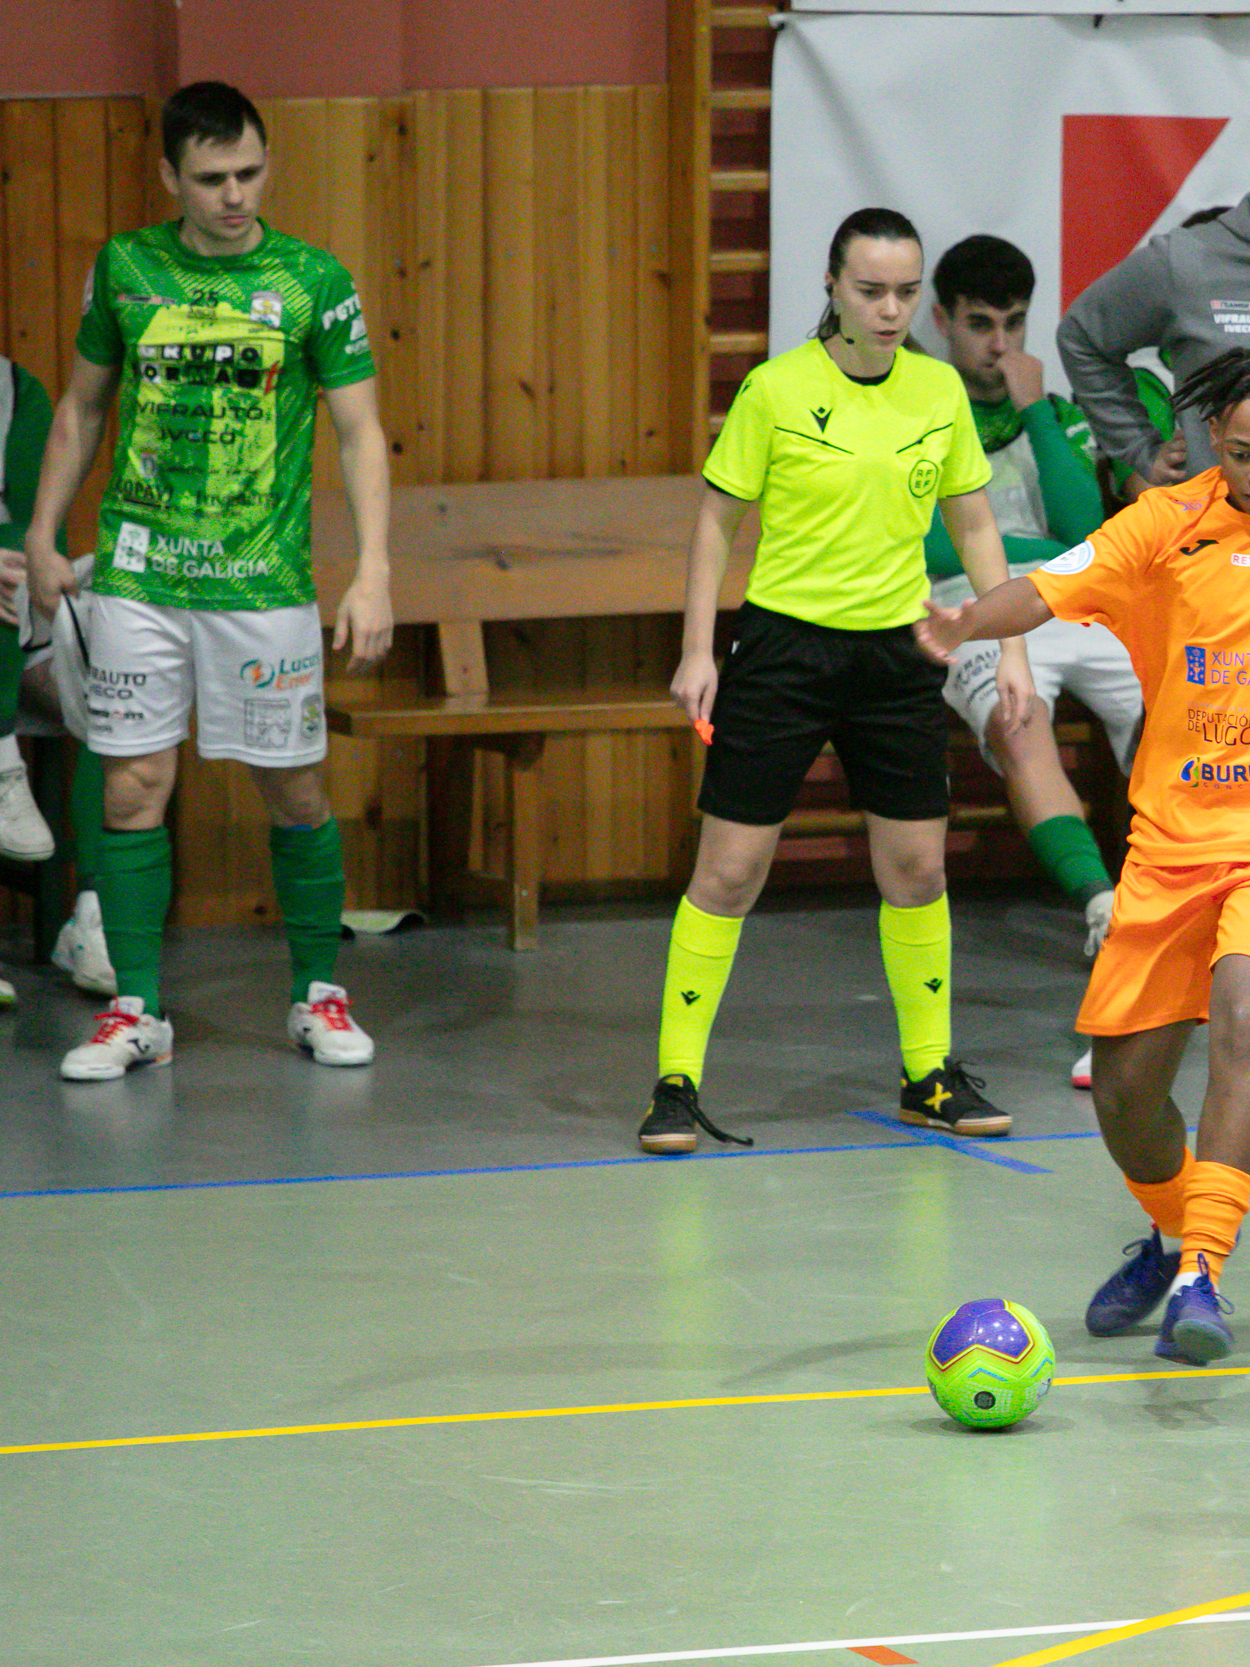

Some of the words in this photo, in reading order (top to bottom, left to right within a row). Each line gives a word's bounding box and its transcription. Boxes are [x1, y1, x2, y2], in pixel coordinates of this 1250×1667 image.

[156, 535, 225, 558] XUNTA
[151, 556, 179, 575] DE
[182, 559, 270, 579] GALICIA
[1211, 670, 1231, 685] DE
[1187, 720, 1202, 733] DE
